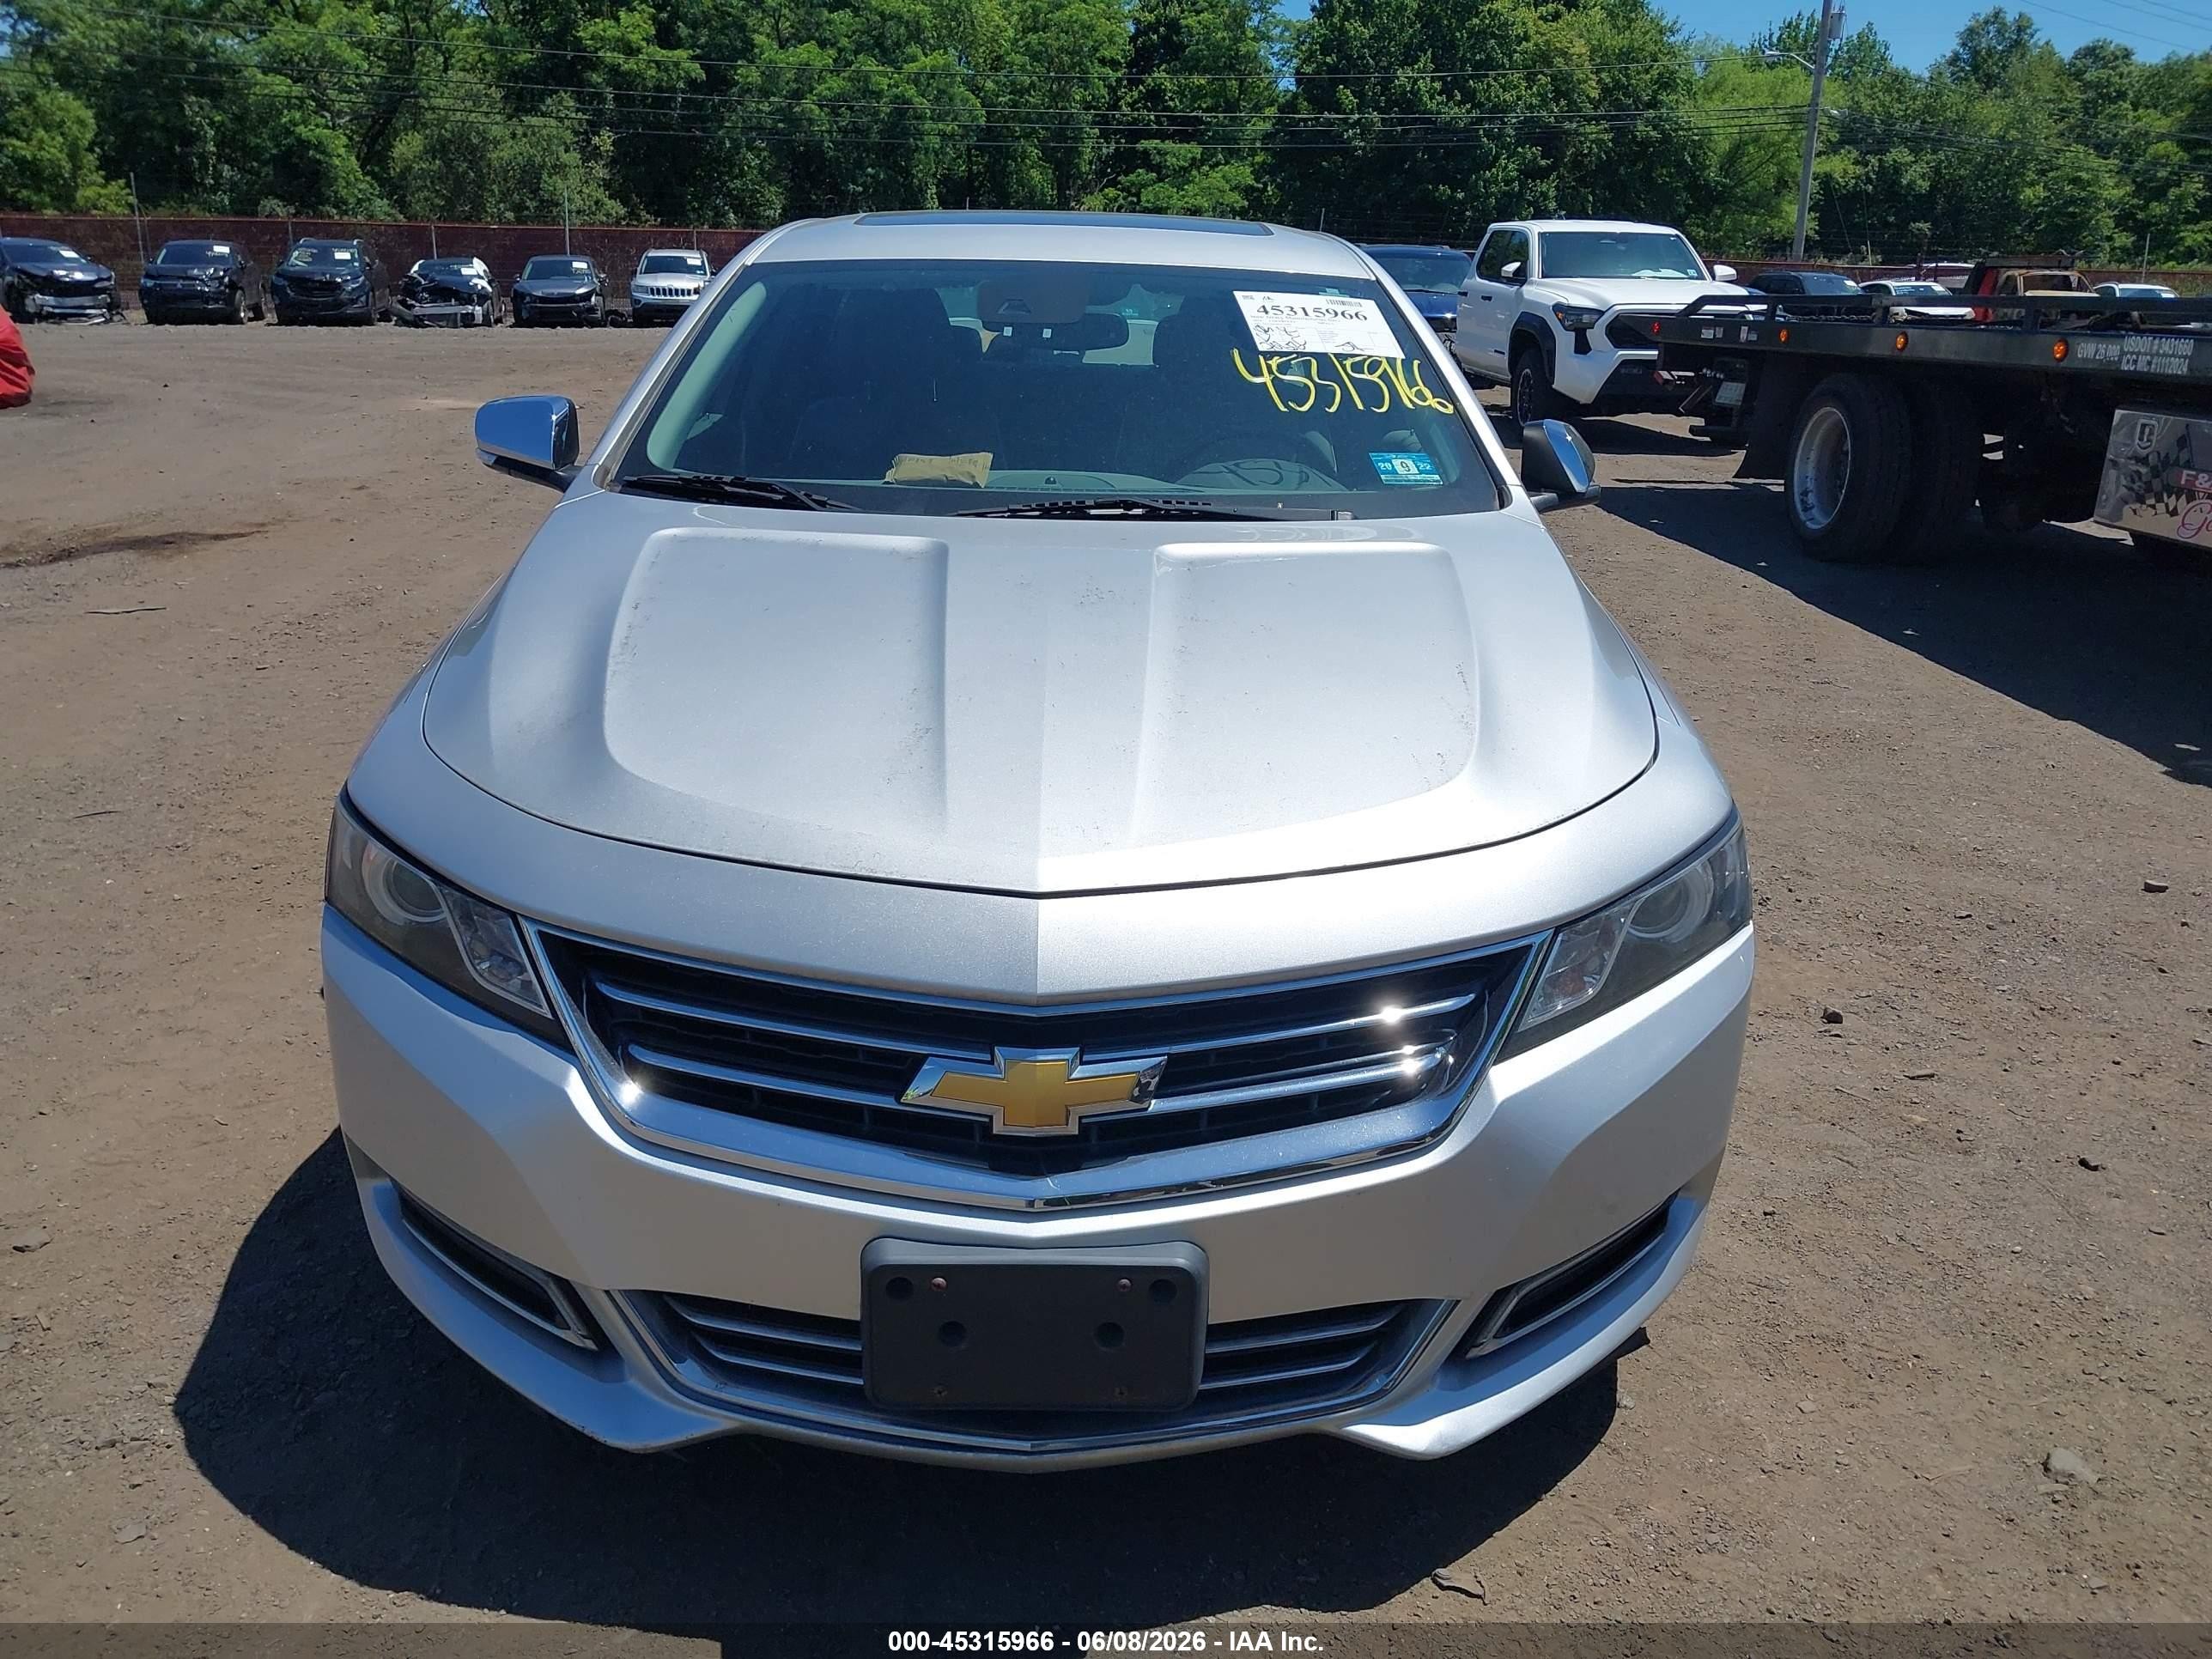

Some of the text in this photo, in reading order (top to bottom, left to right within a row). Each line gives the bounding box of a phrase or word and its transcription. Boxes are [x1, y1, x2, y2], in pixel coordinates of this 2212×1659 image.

[1256, 304, 1368, 321] 45315966
[2077, 343, 2096, 359] GVW
[2123, 336, 2153, 352] USDOT
[2121, 355, 2136, 371] ICC
[2136, 355, 2150, 372] MC
